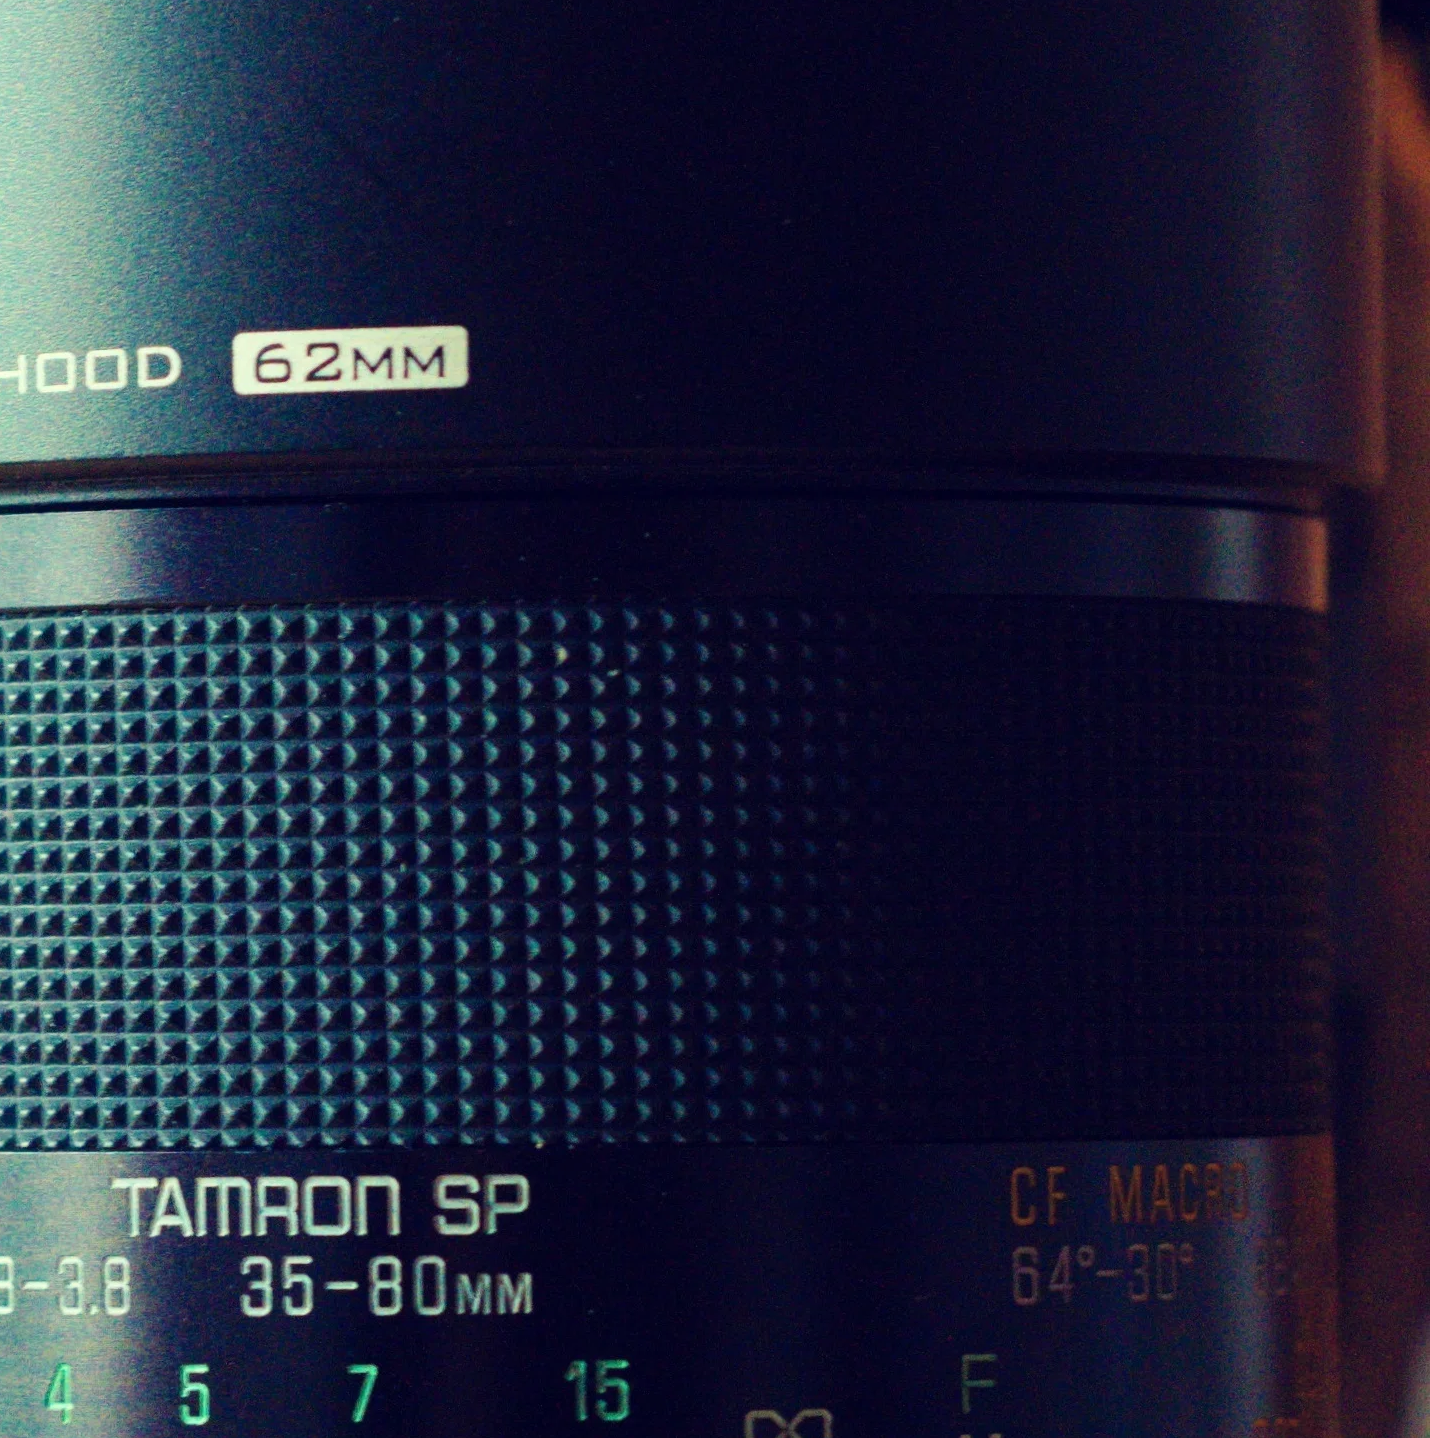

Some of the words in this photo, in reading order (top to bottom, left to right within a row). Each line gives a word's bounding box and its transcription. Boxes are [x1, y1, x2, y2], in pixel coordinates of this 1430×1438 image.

[254, 341, 447, 385] 62MM
[111, 1176, 400, 1238] TAMRON
[436, 1174, 530, 1236] SP
[1009, 1165, 1069, 1227] CF
[1109, 1161, 1248, 1223] MACRO
[44, 1364, 75, 1424] 4
[179, 1364, 211, 1426] 5
[347, 1364, 380, 1423] 7
[565, 1360, 630, 1422] 15
[961, 1353, 998, 1413] F
